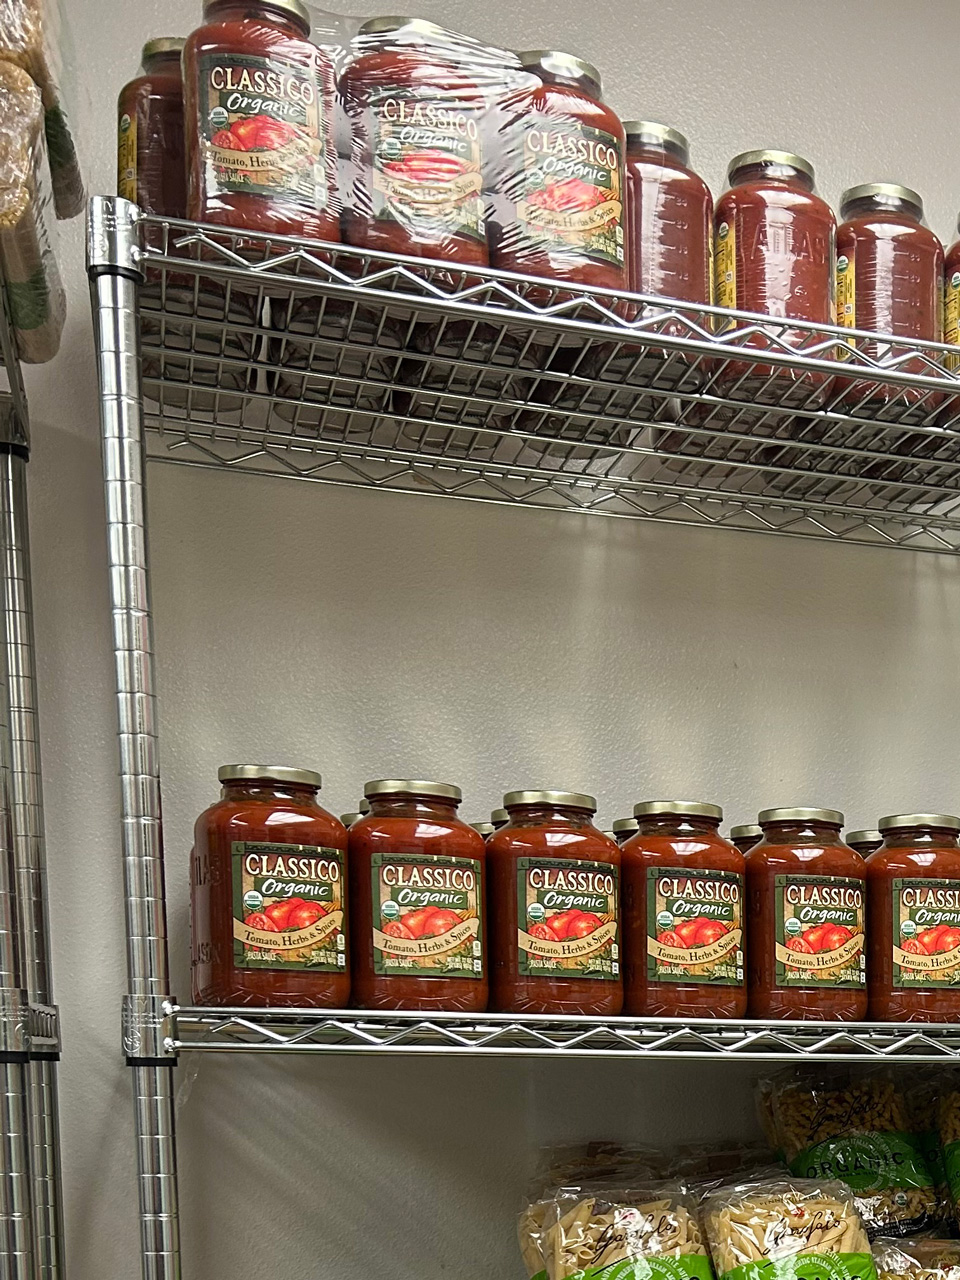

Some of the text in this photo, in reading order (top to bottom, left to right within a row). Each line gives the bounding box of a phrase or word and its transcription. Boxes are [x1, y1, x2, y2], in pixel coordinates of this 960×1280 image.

[211, 66, 313, 105] CLASSICO
[227, 93, 301, 117] Organic
[384, 98, 477, 140] CLASSICO
[401, 126, 468, 151] Organic
[527, 130, 617, 169] CLASSICO
[212, 151, 248, 167] Tomato,
[543, 157, 607, 181] Organic
[246, 854, 339, 882] CLASSICO
[383, 865, 474, 890] CLASSICO
[262, 879, 329, 898] Organic
[530, 868, 612, 895] CLASSICO
[658, 877, 738, 903] CLASSICO
[398, 888, 464, 905] Organic
[544, 891, 604, 911] Organic
[672, 900, 729, 918] Organic
[787, 885, 862, 909] CLASSICO
[800, 907, 854, 923] Organic
[245, 918, 336, 948] Tomato, Herbs & Spices
[383, 925, 471, 955] Tomato, Herbs & Spices
[528, 928, 610, 956] Tomato, Herbs & Spices
[247, 953, 276, 962] PASTA SAUCE
[657, 935, 736, 962] Tomato, Herbs & Spices
[785, 941, 859, 967] Tomato, Herbs & Spices
[901, 954, 929, 969] Tomato,
[931, 957, 952, 968] Herbs
[953, 954, 959, 962] &
[807, 1152, 904, 1179] ORGANIC
